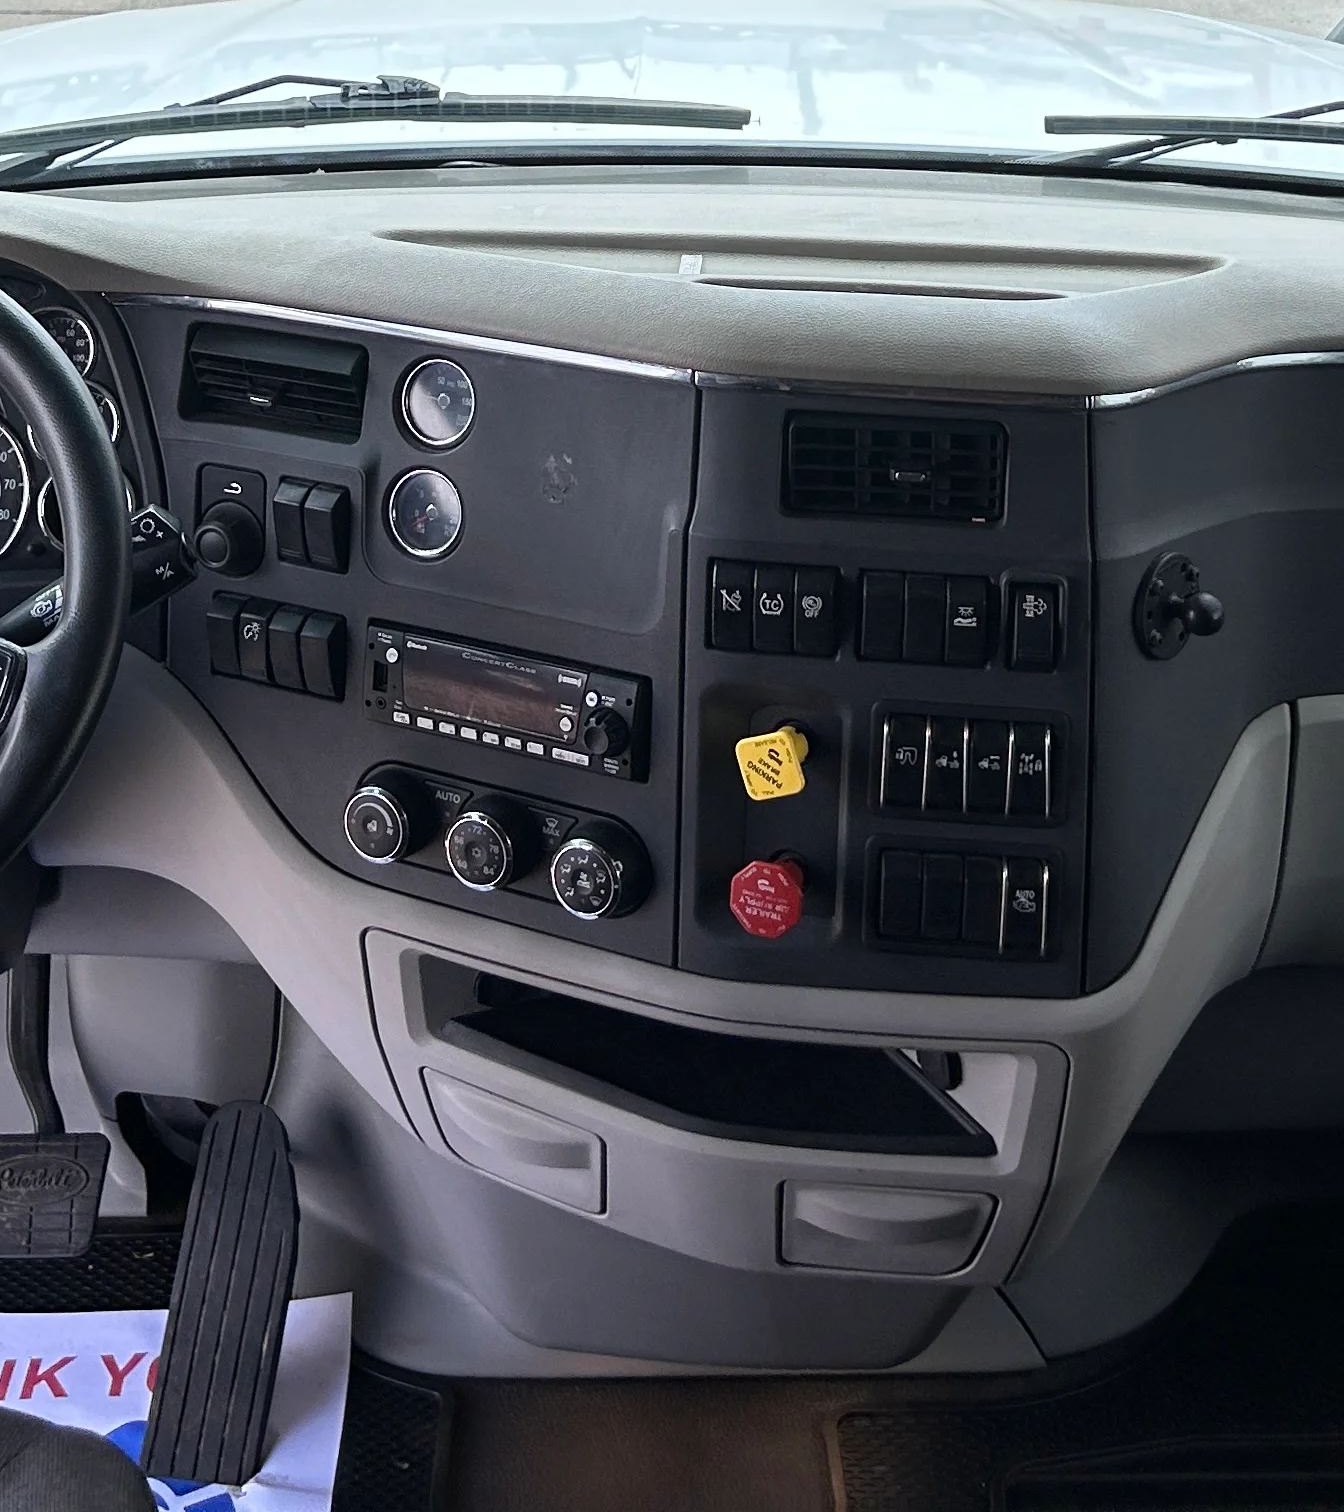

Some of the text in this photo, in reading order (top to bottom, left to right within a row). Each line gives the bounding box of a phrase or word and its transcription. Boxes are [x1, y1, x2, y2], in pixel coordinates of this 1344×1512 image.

[4, 478, 16, 490] 70
[764, 599, 779, 611] TC
[758, 757, 781, 776] BRAKE
[747, 760, 783, 789] PARKING
[435, 790, 462, 805] AUTO
[471, 824, 484, 835] 72
[541, 826, 561, 838] MAX
[483, 865, 495, 876] 84
[1015, 889, 1036, 900] AUTO
[745, 906, 782, 921] TRAILER
